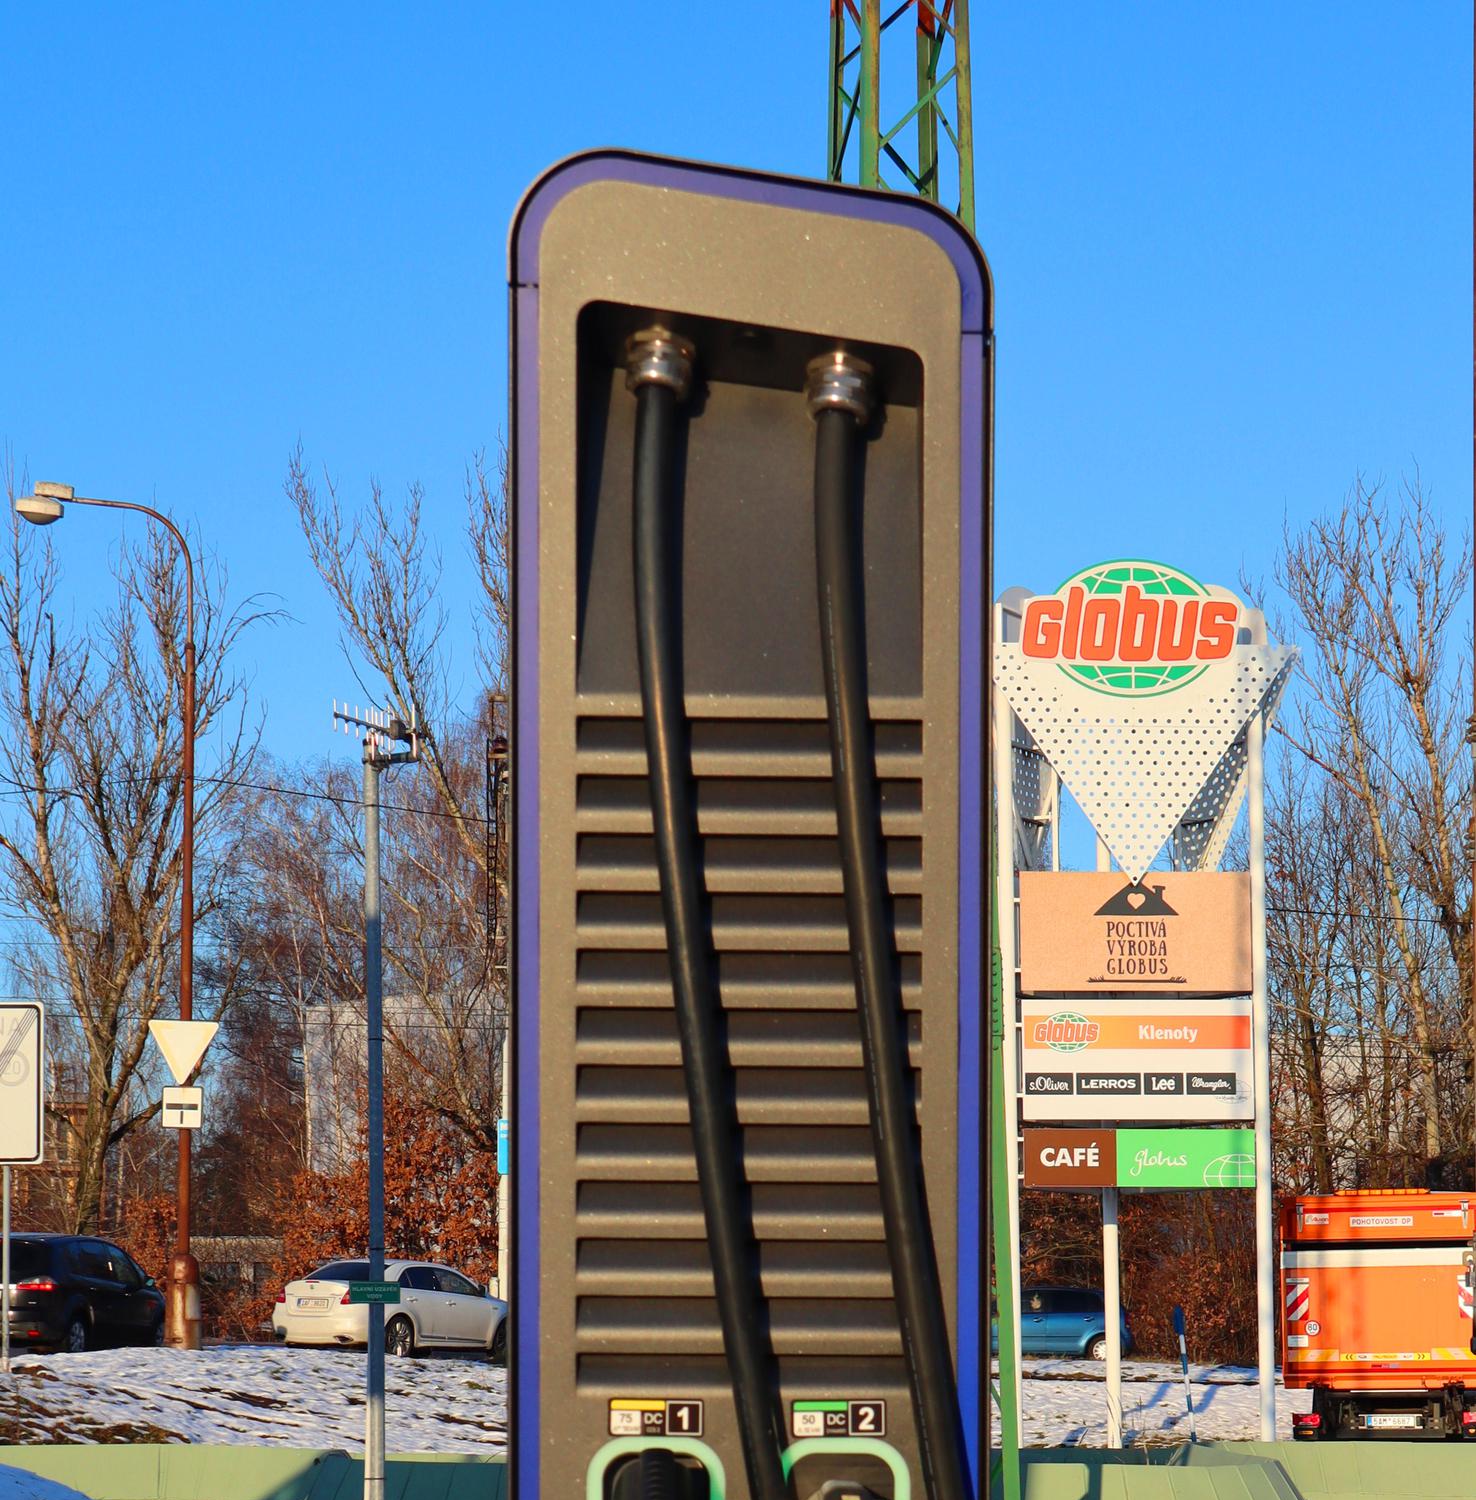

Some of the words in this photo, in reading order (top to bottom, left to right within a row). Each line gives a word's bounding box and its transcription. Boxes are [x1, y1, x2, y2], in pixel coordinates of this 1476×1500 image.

[1022, 585, 1238, 661] Globus
[1106, 918, 1167, 938] POCTIVÁ
[1106, 935, 1167, 956] VÝROBA
[1106, 958, 1168, 975] GLOBUS
[1034, 1019, 1099, 1042] Globus
[1138, 1025, 1198, 1042] Klenoty
[1029, 1075, 1069, 1092] s.Oliver
[1081, 1079, 1136, 1089] LERROS
[1152, 1077, 1175, 1091] Lee
[1191, 1076, 1231, 1091] Wrangler
[1040, 1143, 1100, 1167] CAFÉ
[619, 1413, 633, 1423] 75
[644, 1412, 663, 1424] DC
[676, 1406, 689, 1431] 1
[802, 1414, 816, 1424] 50
[826, 1413, 846, 1425] DC
[858, 1406, 875, 1431] 2
